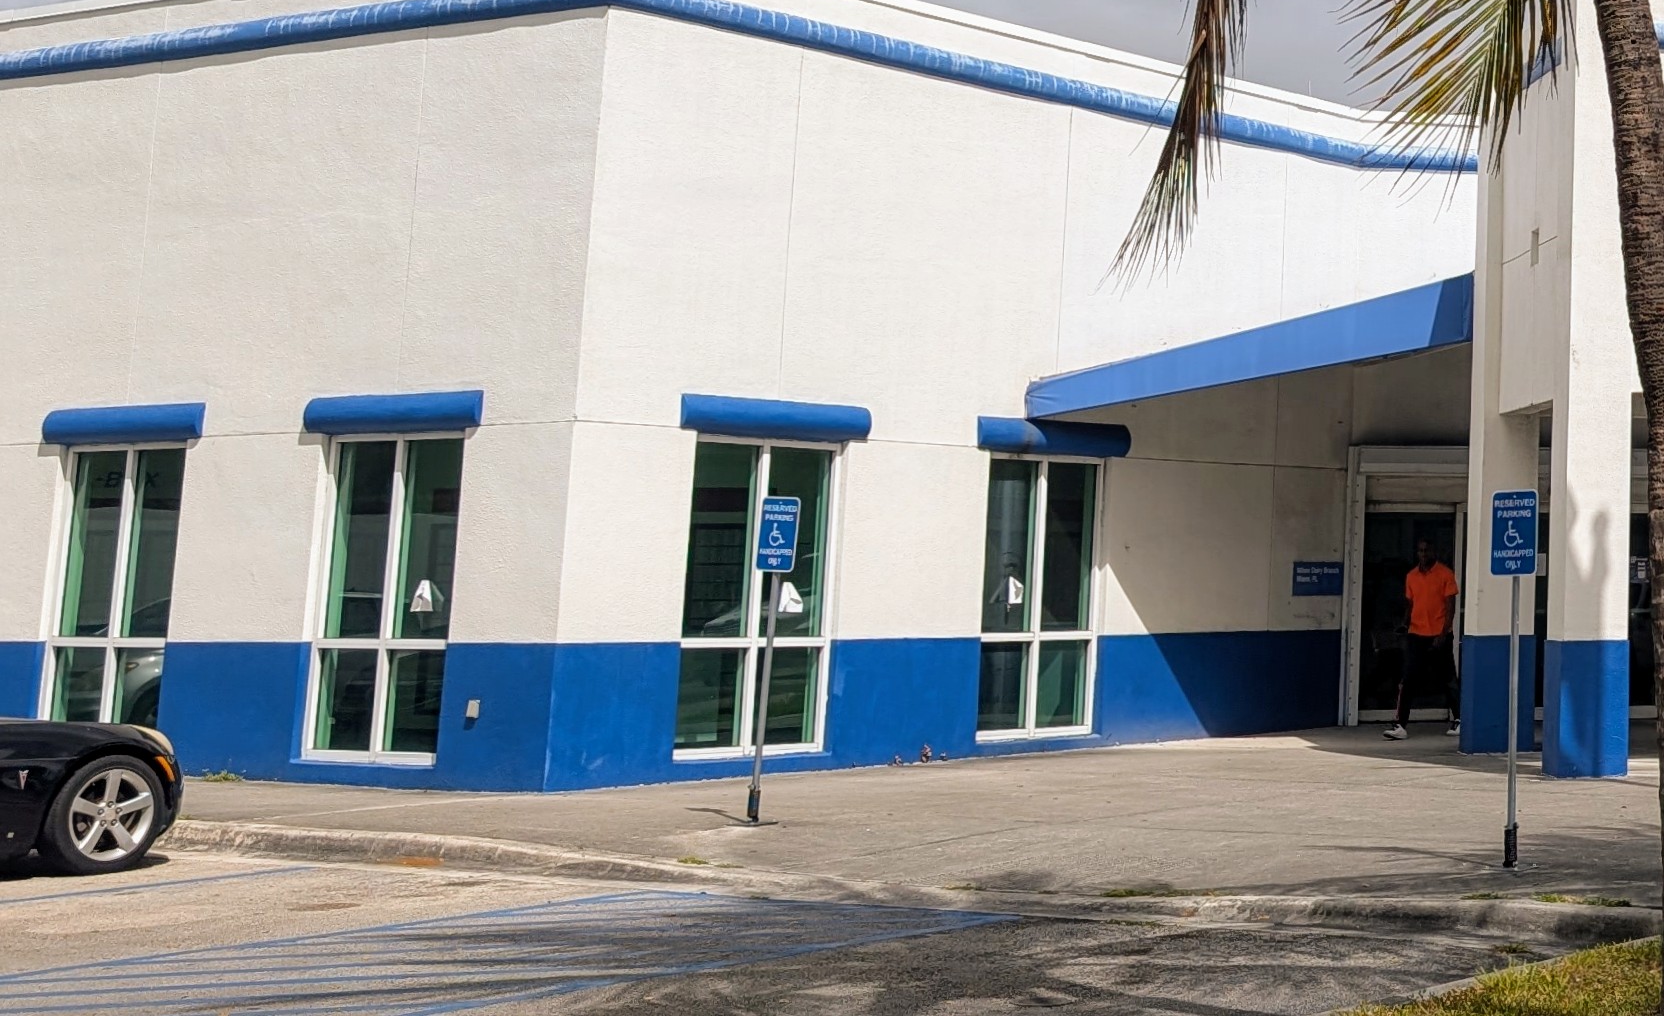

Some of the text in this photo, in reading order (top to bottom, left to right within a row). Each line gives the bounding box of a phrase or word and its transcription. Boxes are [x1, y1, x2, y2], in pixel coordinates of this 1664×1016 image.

[1494, 499, 1535, 508] RESERVED
[763, 504, 797, 513] RESERVED
[765, 514, 794, 522] PARKING
[1497, 509, 1531, 518] PARKING
[1493, 548, 1534, 559] HANDICAPPED
[1504, 560, 1521, 570] ONLY
